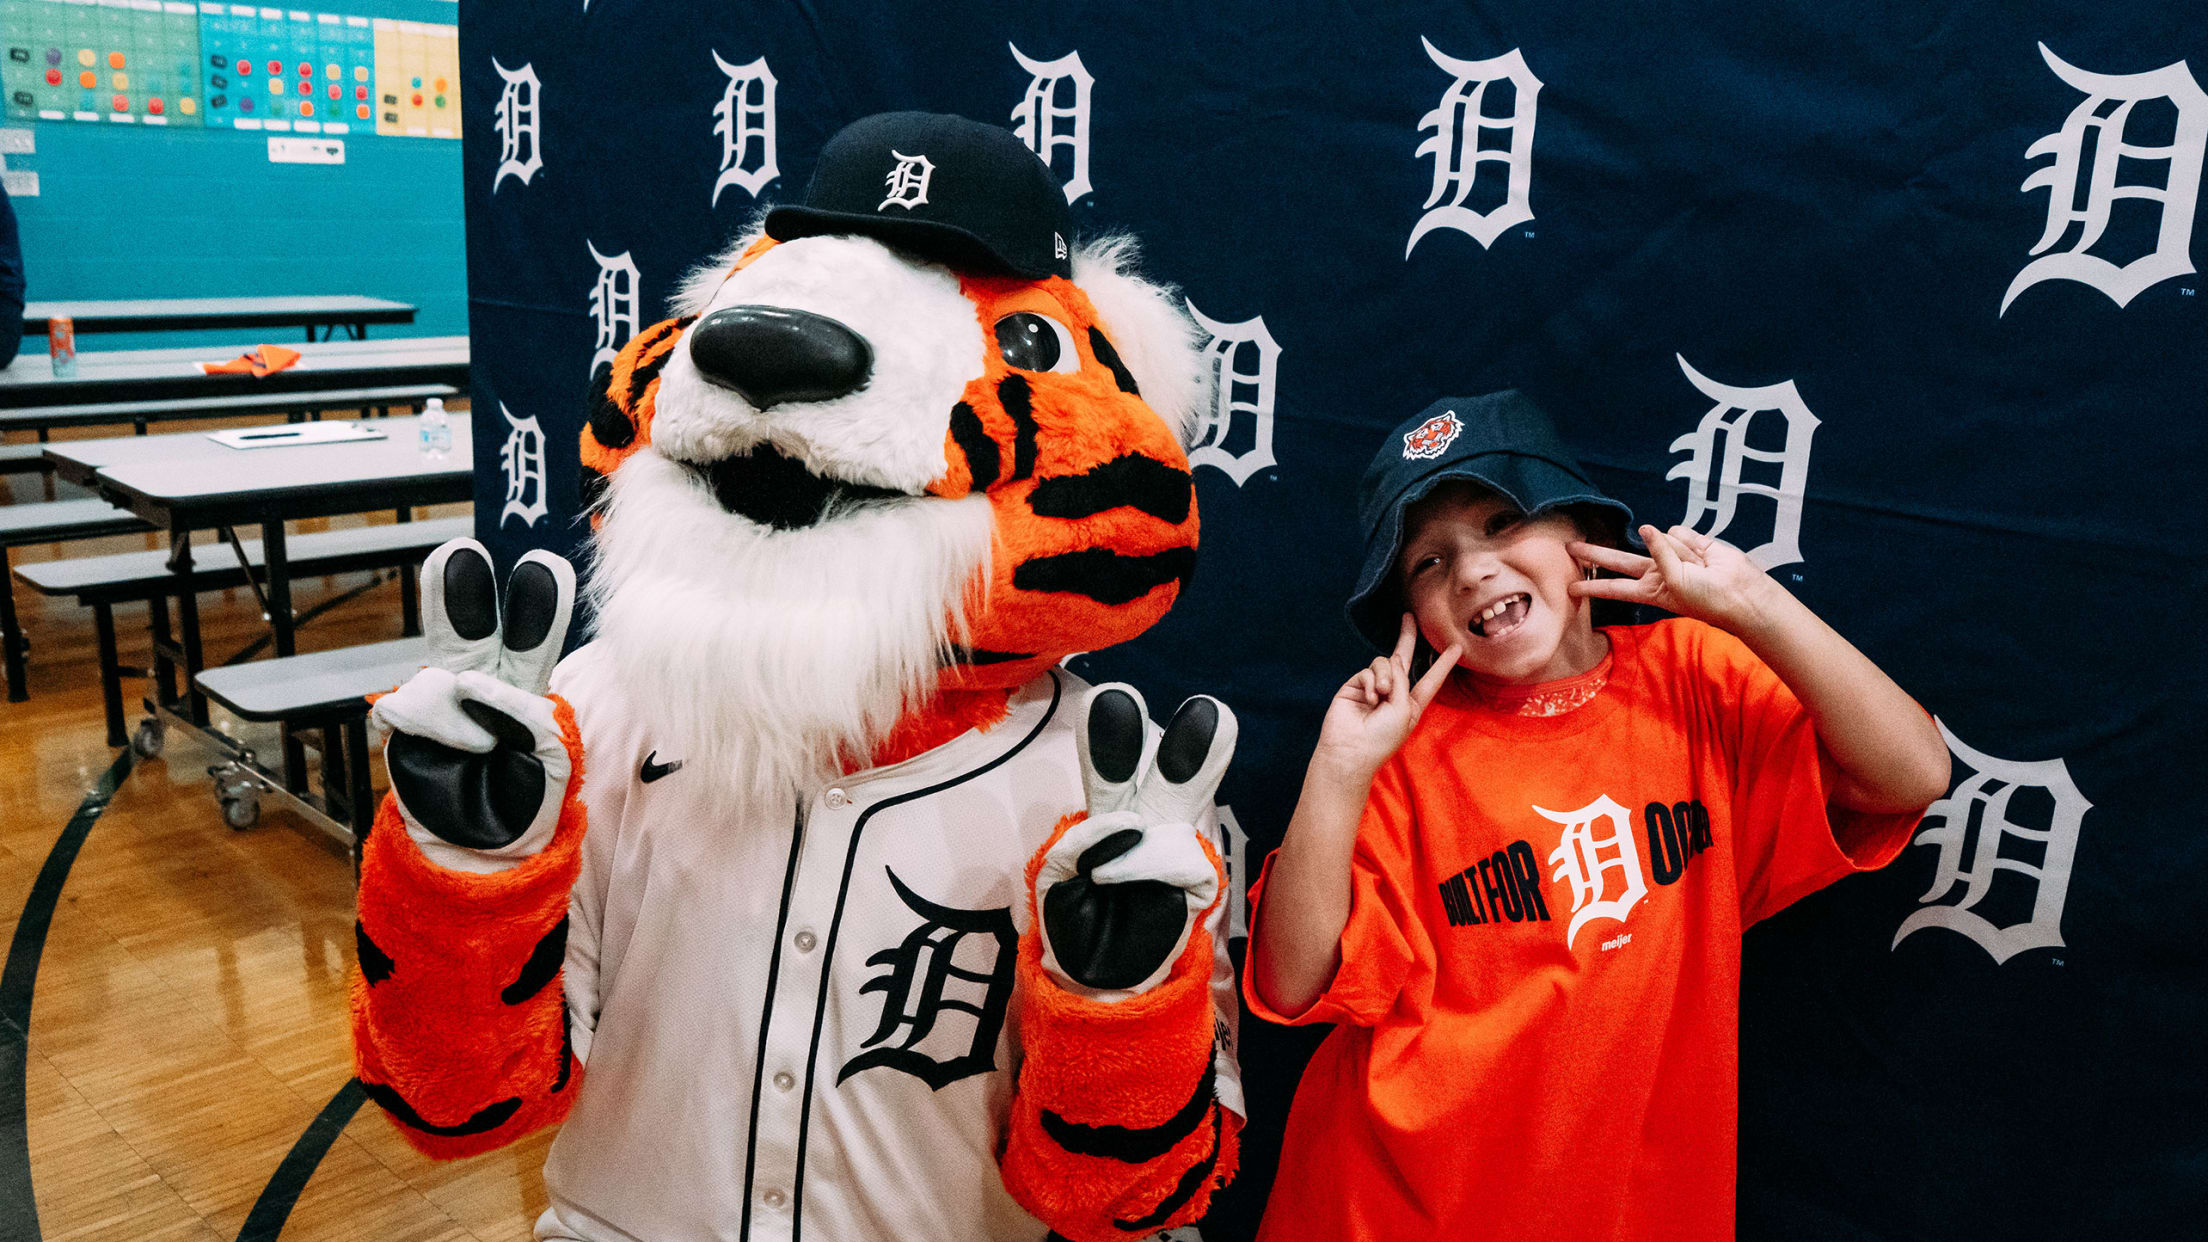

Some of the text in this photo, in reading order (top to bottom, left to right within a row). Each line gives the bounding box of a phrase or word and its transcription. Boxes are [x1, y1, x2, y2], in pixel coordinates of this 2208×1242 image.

[491, 56, 544, 194] D
[712, 48, 781, 208] D
[877, 149, 936, 212] D
[1008, 40, 1096, 207] D
[1406, 34, 1545, 261] D
[2000, 40, 2208, 318] D
[587, 238, 642, 381] D
[1185, 295, 1284, 488] D
[499, 400, 549, 530] D
[1665, 352, 1823, 573] D
[1891, 713, 2095, 967] D
[835, 864, 1019, 1092] D
[1601, 932, 1633, 952] meijer
